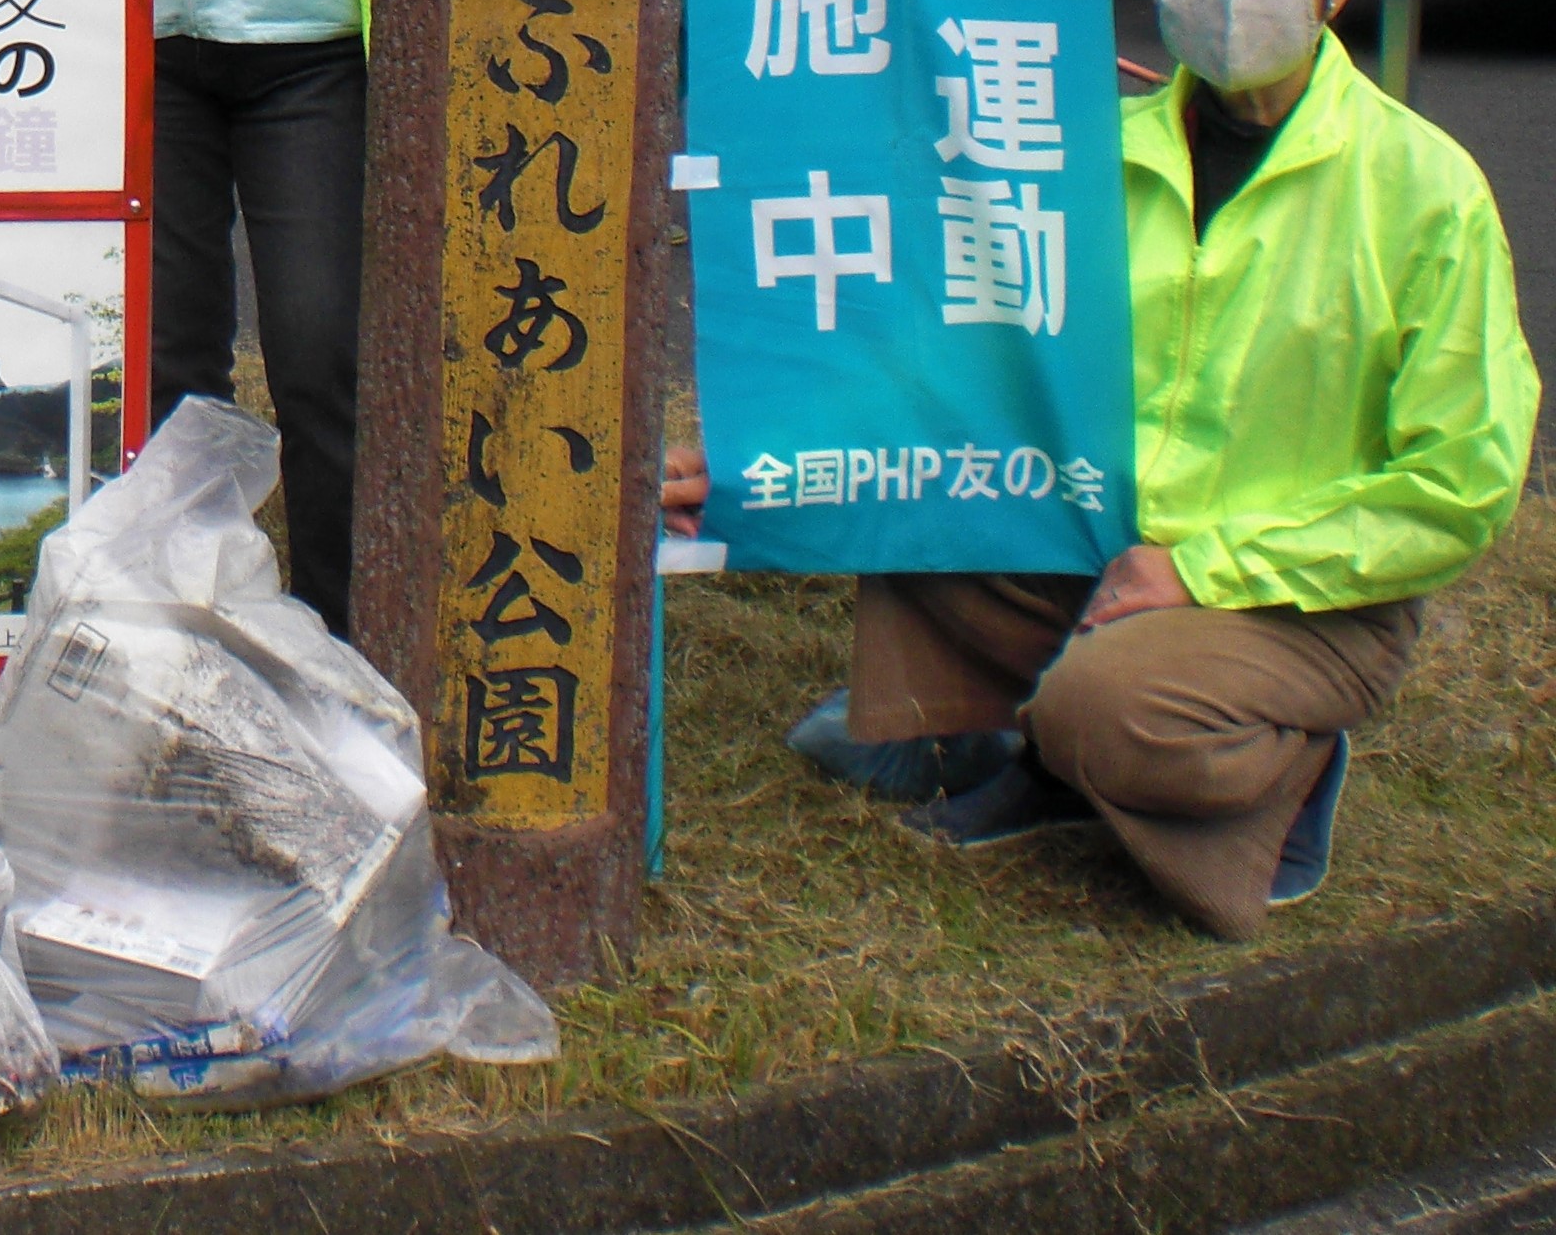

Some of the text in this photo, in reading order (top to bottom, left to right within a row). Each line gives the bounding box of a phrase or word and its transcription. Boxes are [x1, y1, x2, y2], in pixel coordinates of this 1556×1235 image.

[741, 442, 1105, 513] 全国PHP友の会
